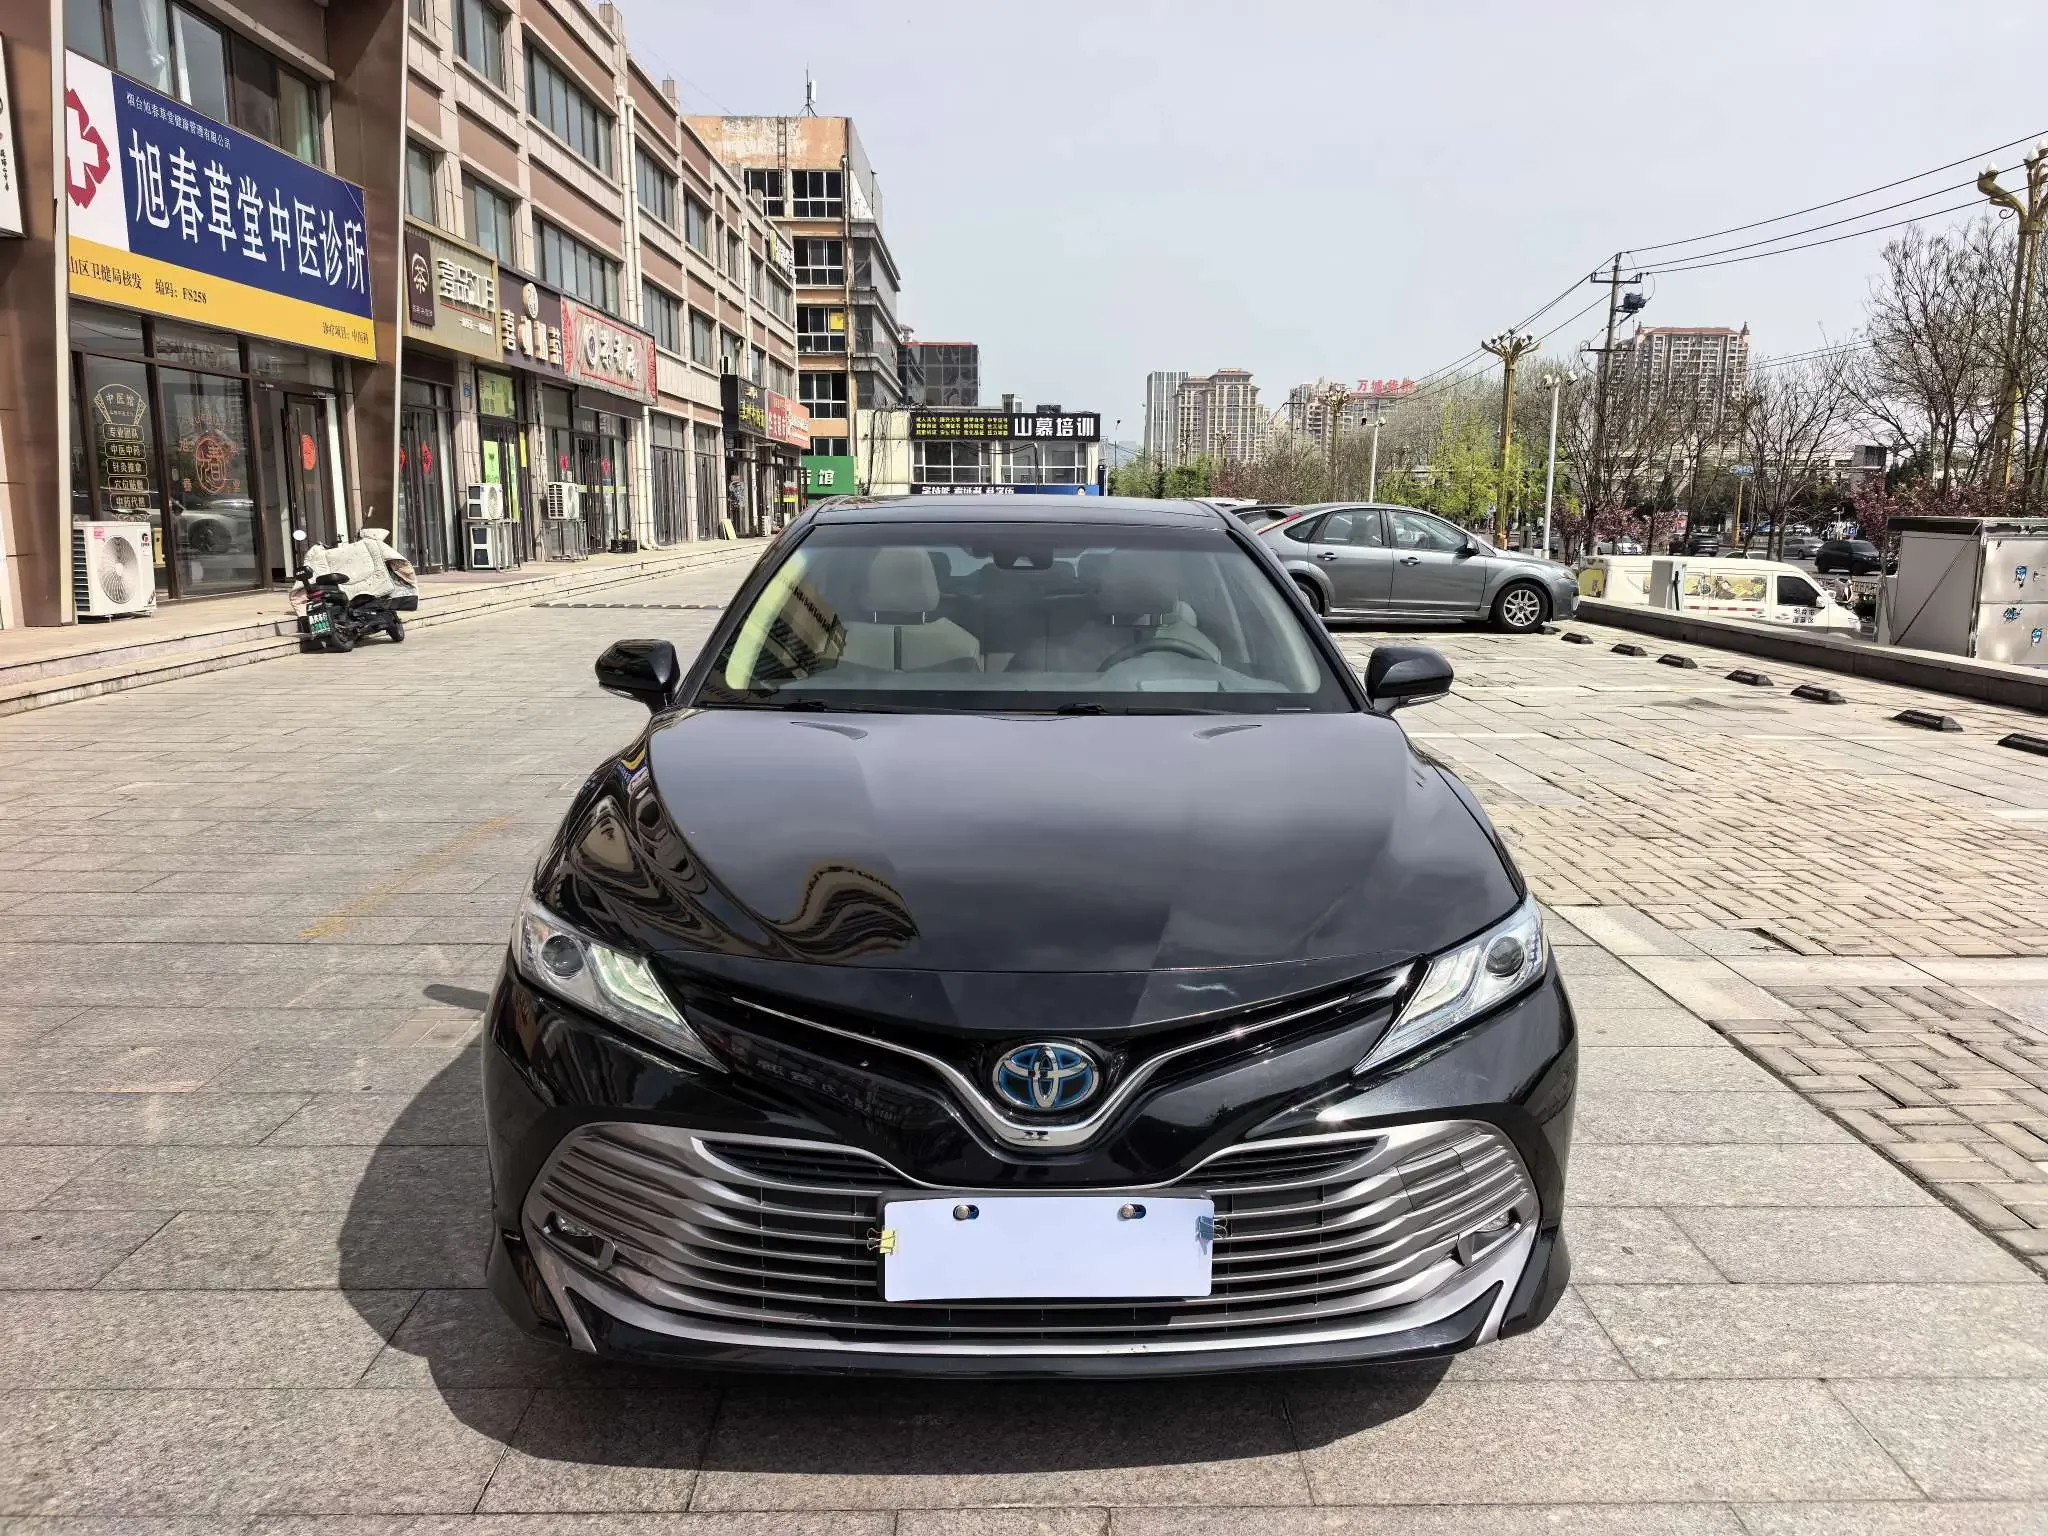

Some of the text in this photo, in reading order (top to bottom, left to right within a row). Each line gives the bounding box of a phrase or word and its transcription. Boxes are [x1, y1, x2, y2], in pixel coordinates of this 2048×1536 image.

[128, 127, 365, 294] 旭春草堂中医诊所
[1014, 417, 1094, 436] 山慕培训
[110, 444, 141, 456] 中医中药
[112, 461, 142, 473] 针灸推拿
